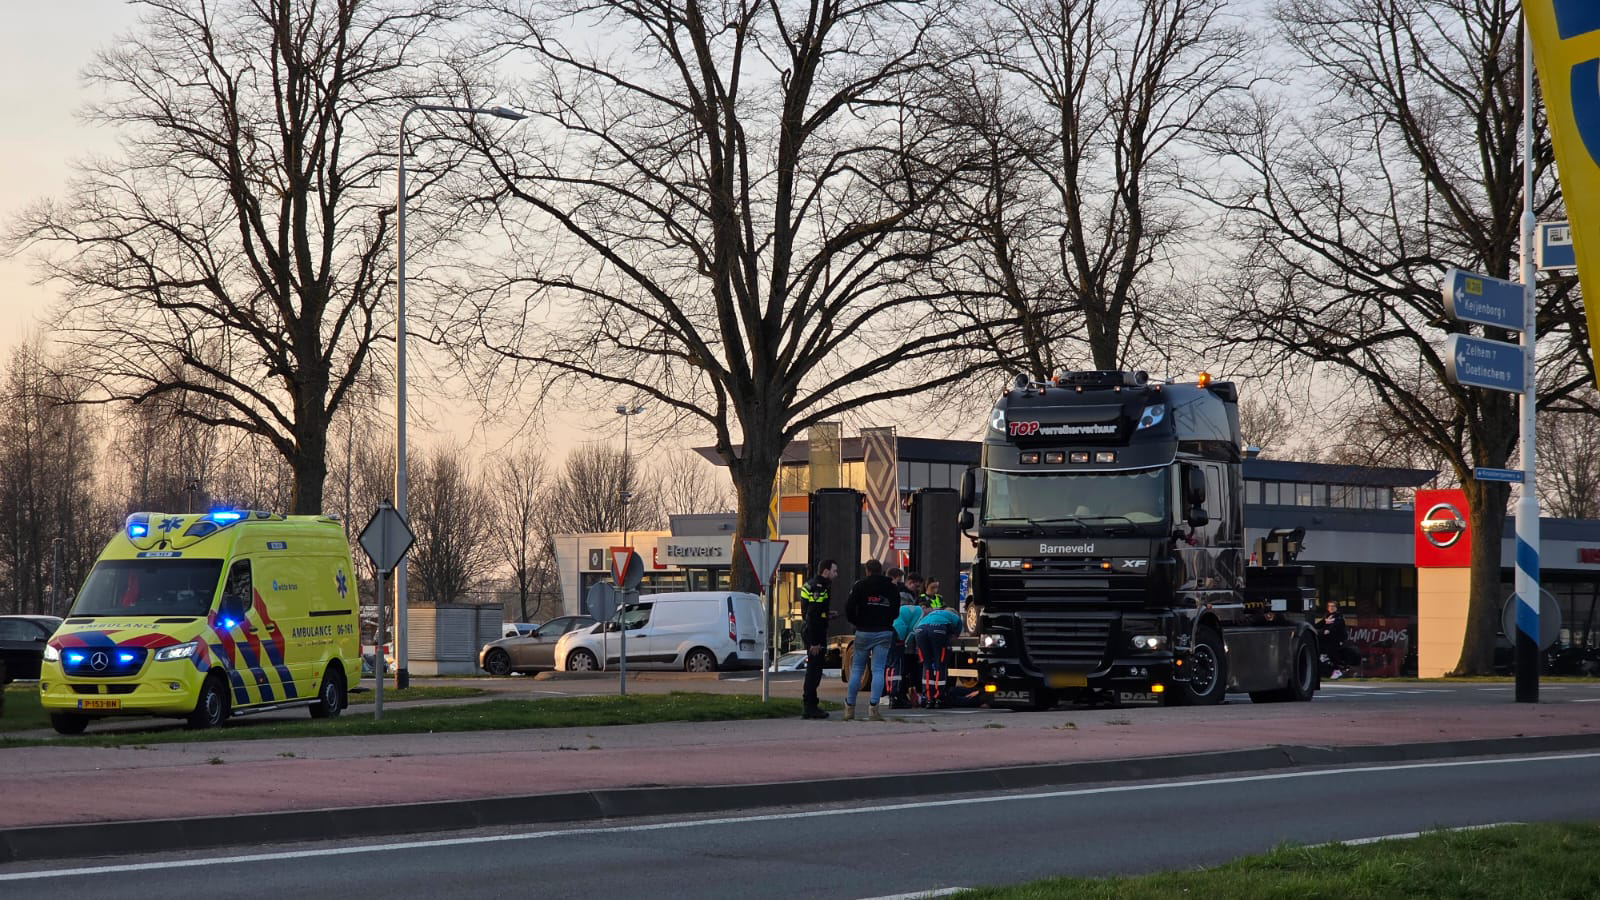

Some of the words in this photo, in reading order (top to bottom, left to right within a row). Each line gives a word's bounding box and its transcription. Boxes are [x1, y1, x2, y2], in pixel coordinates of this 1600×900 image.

[1464, 299, 1501, 320] Keijenborg
[1465, 343, 1491, 359] Zelhem
[1492, 350, 1497, 359] 7
[1465, 363, 1505, 381] Doetinchem
[1506, 371, 1511, 381] 9
[1009, 420, 1040, 436] TOP
[667, 545, 722, 557] Herwers
[1039, 543, 1094, 553] Barneveld
[990, 560, 1021, 568] DAF
[1121, 560, 1147, 568] XF
[292, 625, 332, 638] AMBULANCE
[337, 624, 354, 635] 06-161
[1379, 628, 1408, 642] DAYS
[1120, 692, 1158, 700] DAF
